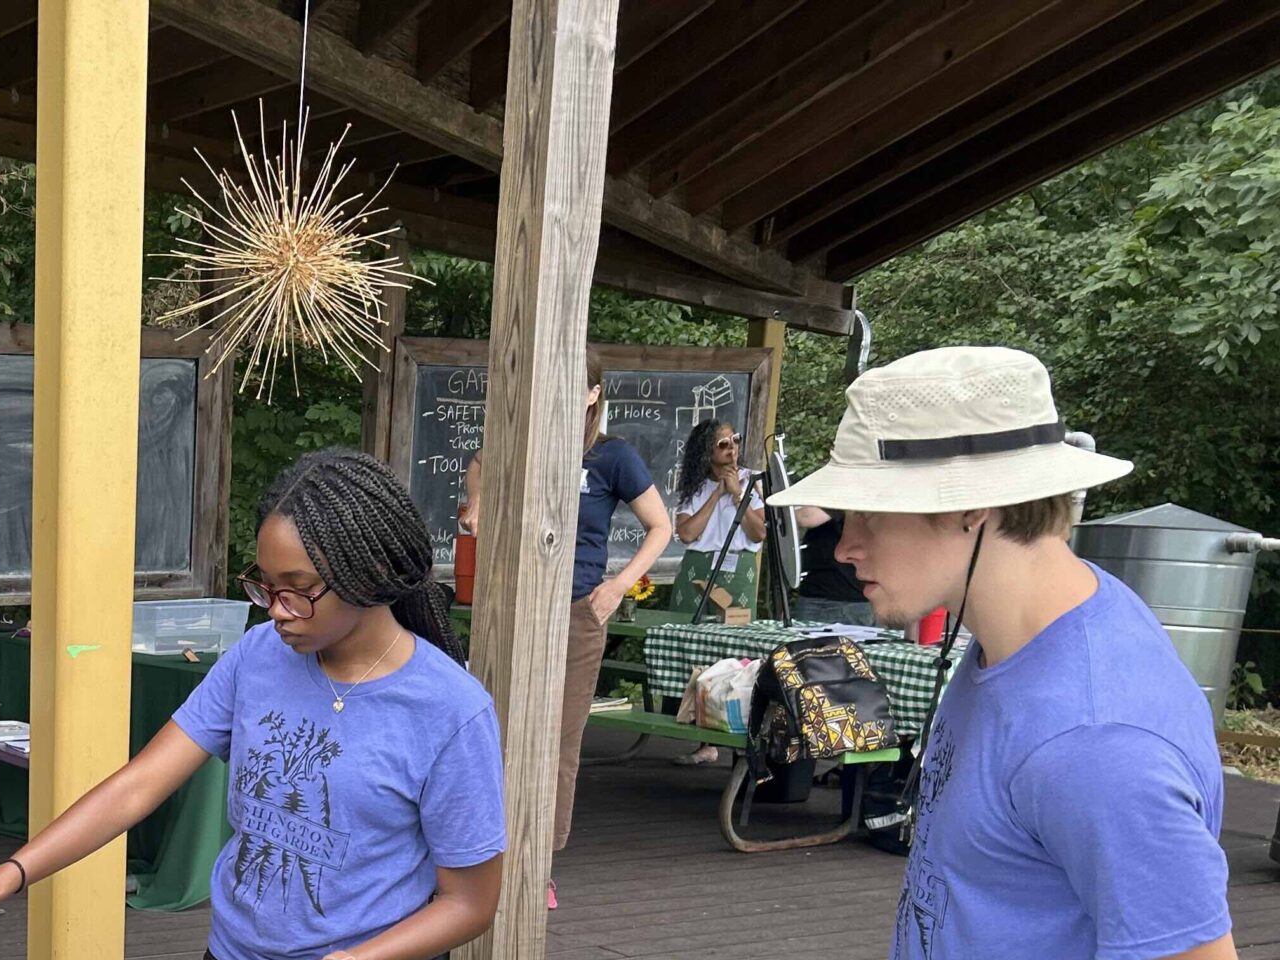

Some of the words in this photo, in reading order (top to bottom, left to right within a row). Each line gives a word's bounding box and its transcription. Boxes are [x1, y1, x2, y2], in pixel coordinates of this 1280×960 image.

[624, 404, 662, 421] Holes
[243, 803, 338, 848] SHINGTON
[271, 827, 332, 860] GARDEN
